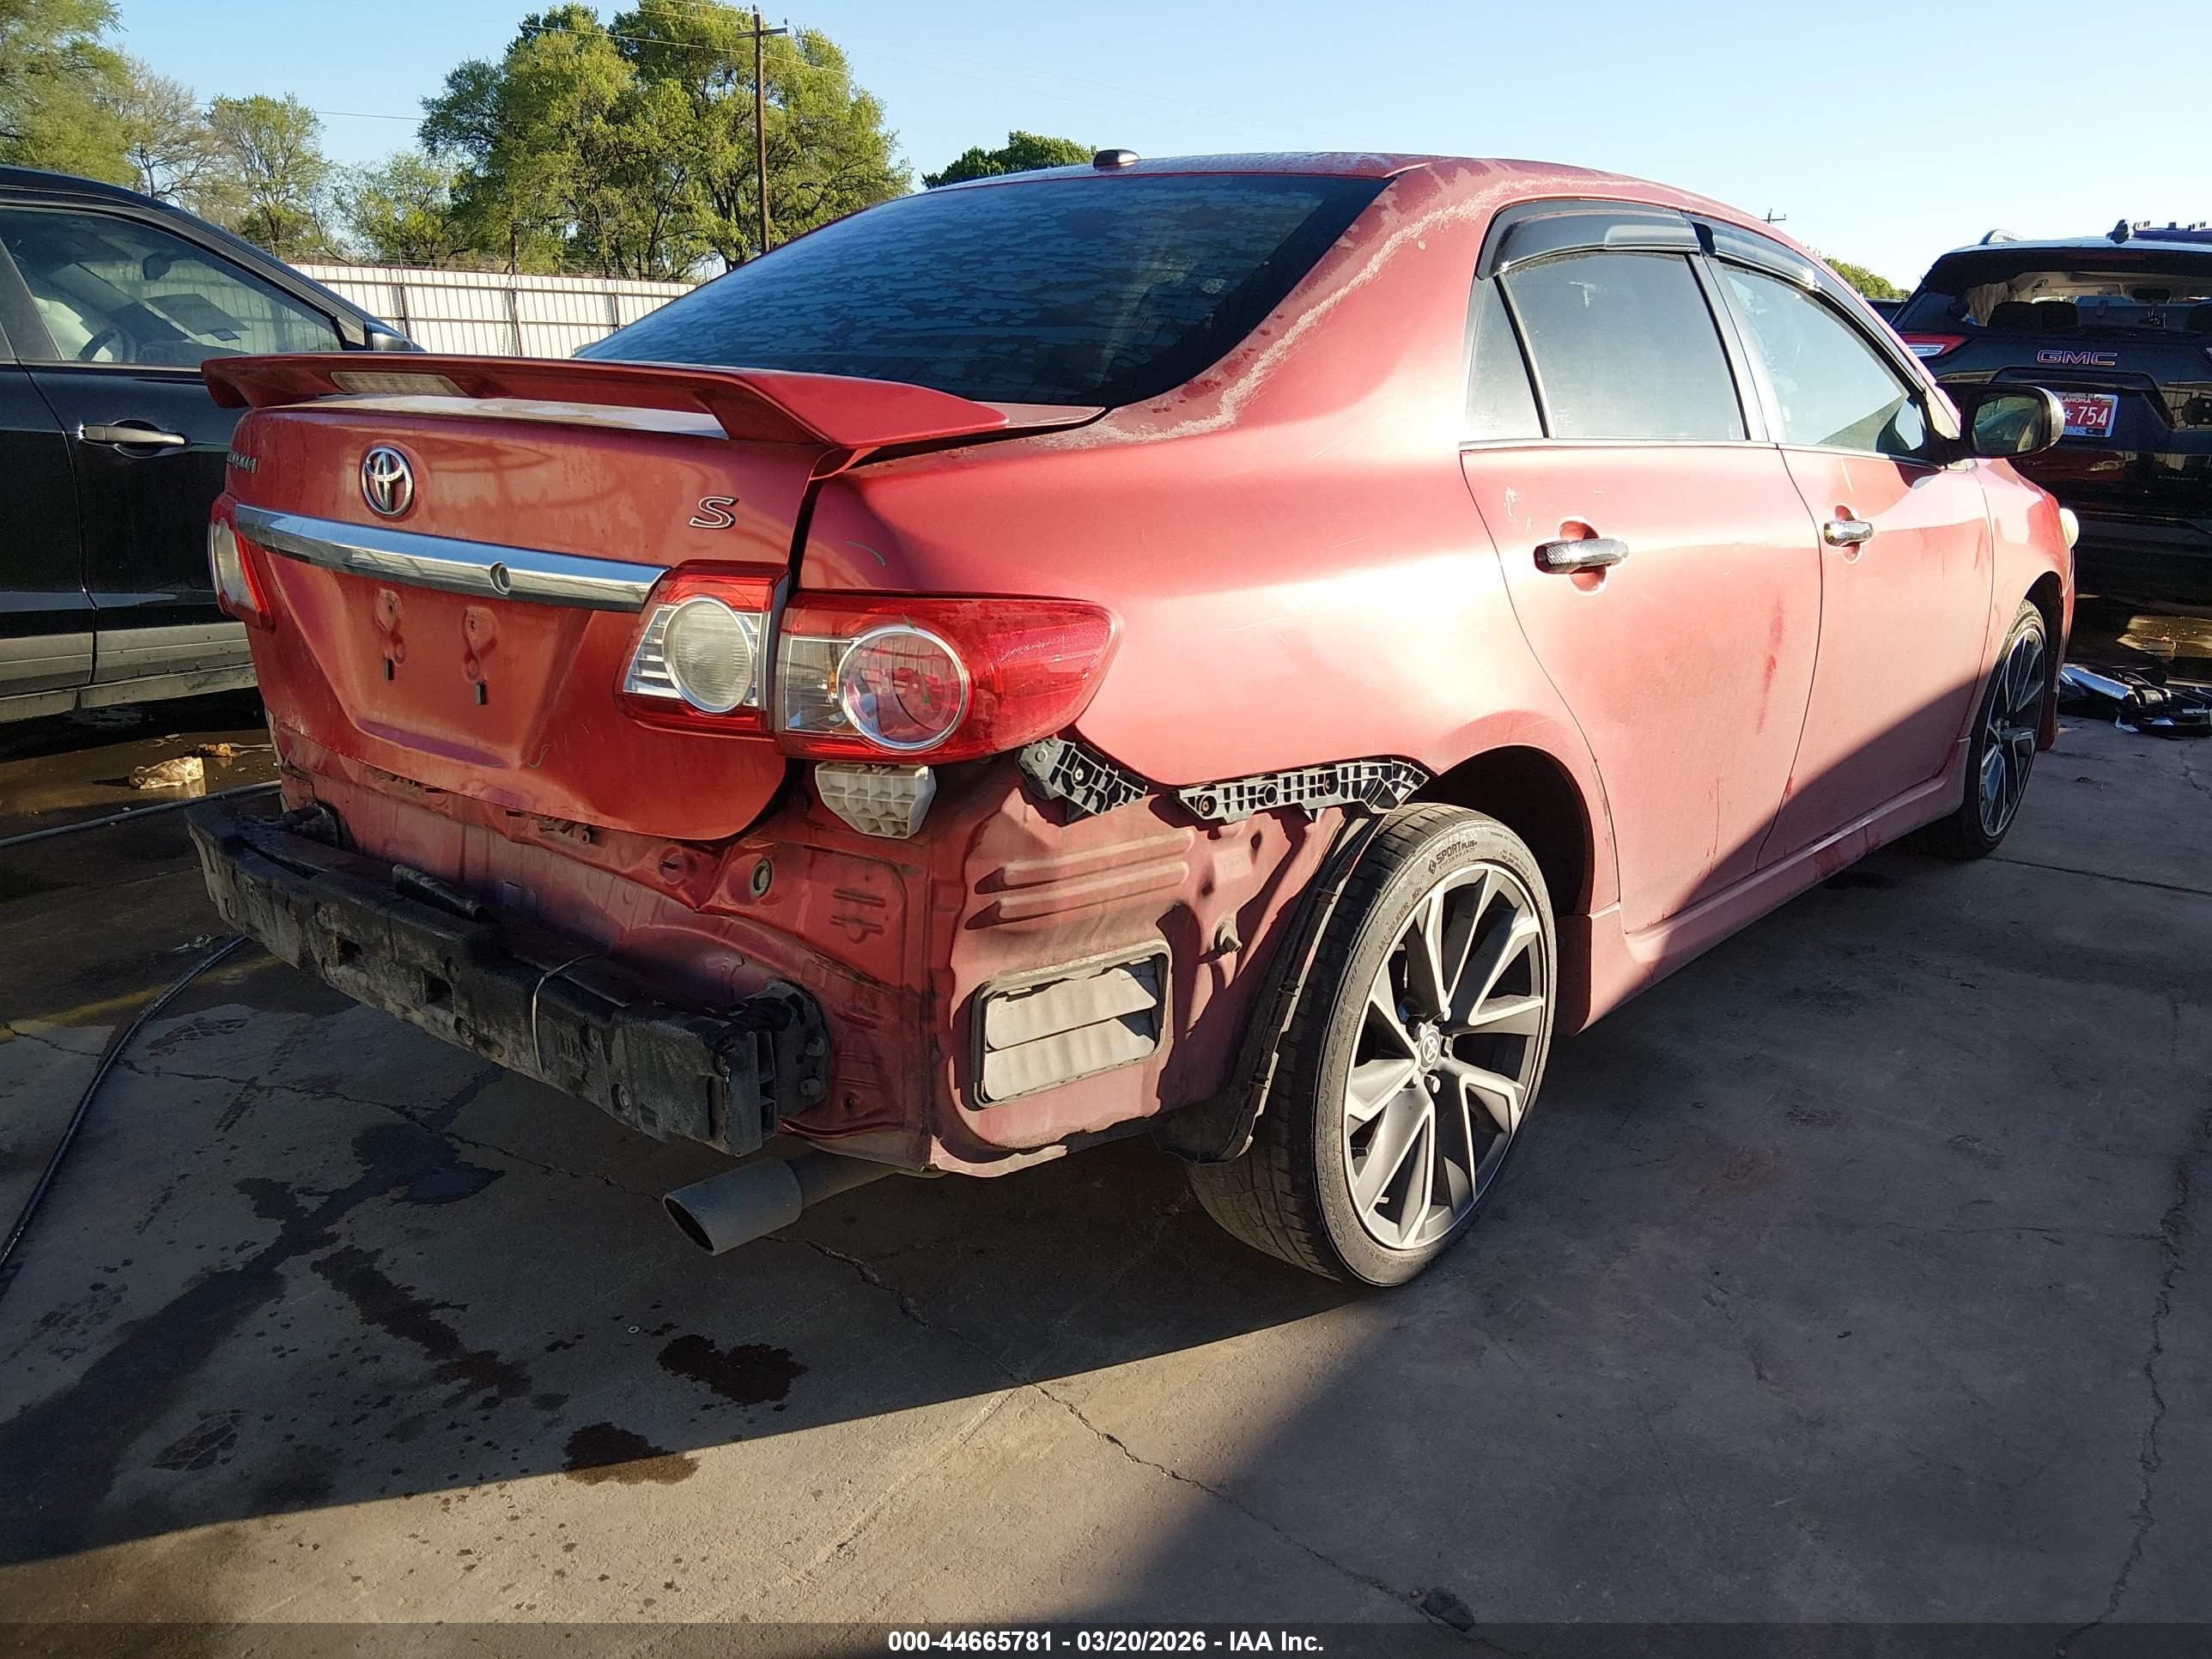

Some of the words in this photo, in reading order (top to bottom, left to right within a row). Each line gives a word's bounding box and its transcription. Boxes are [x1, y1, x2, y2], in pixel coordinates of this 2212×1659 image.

[2036, 350, 2117, 366] GMC
[2077, 407, 2109, 426] 754
[689, 495, 737, 529] S
